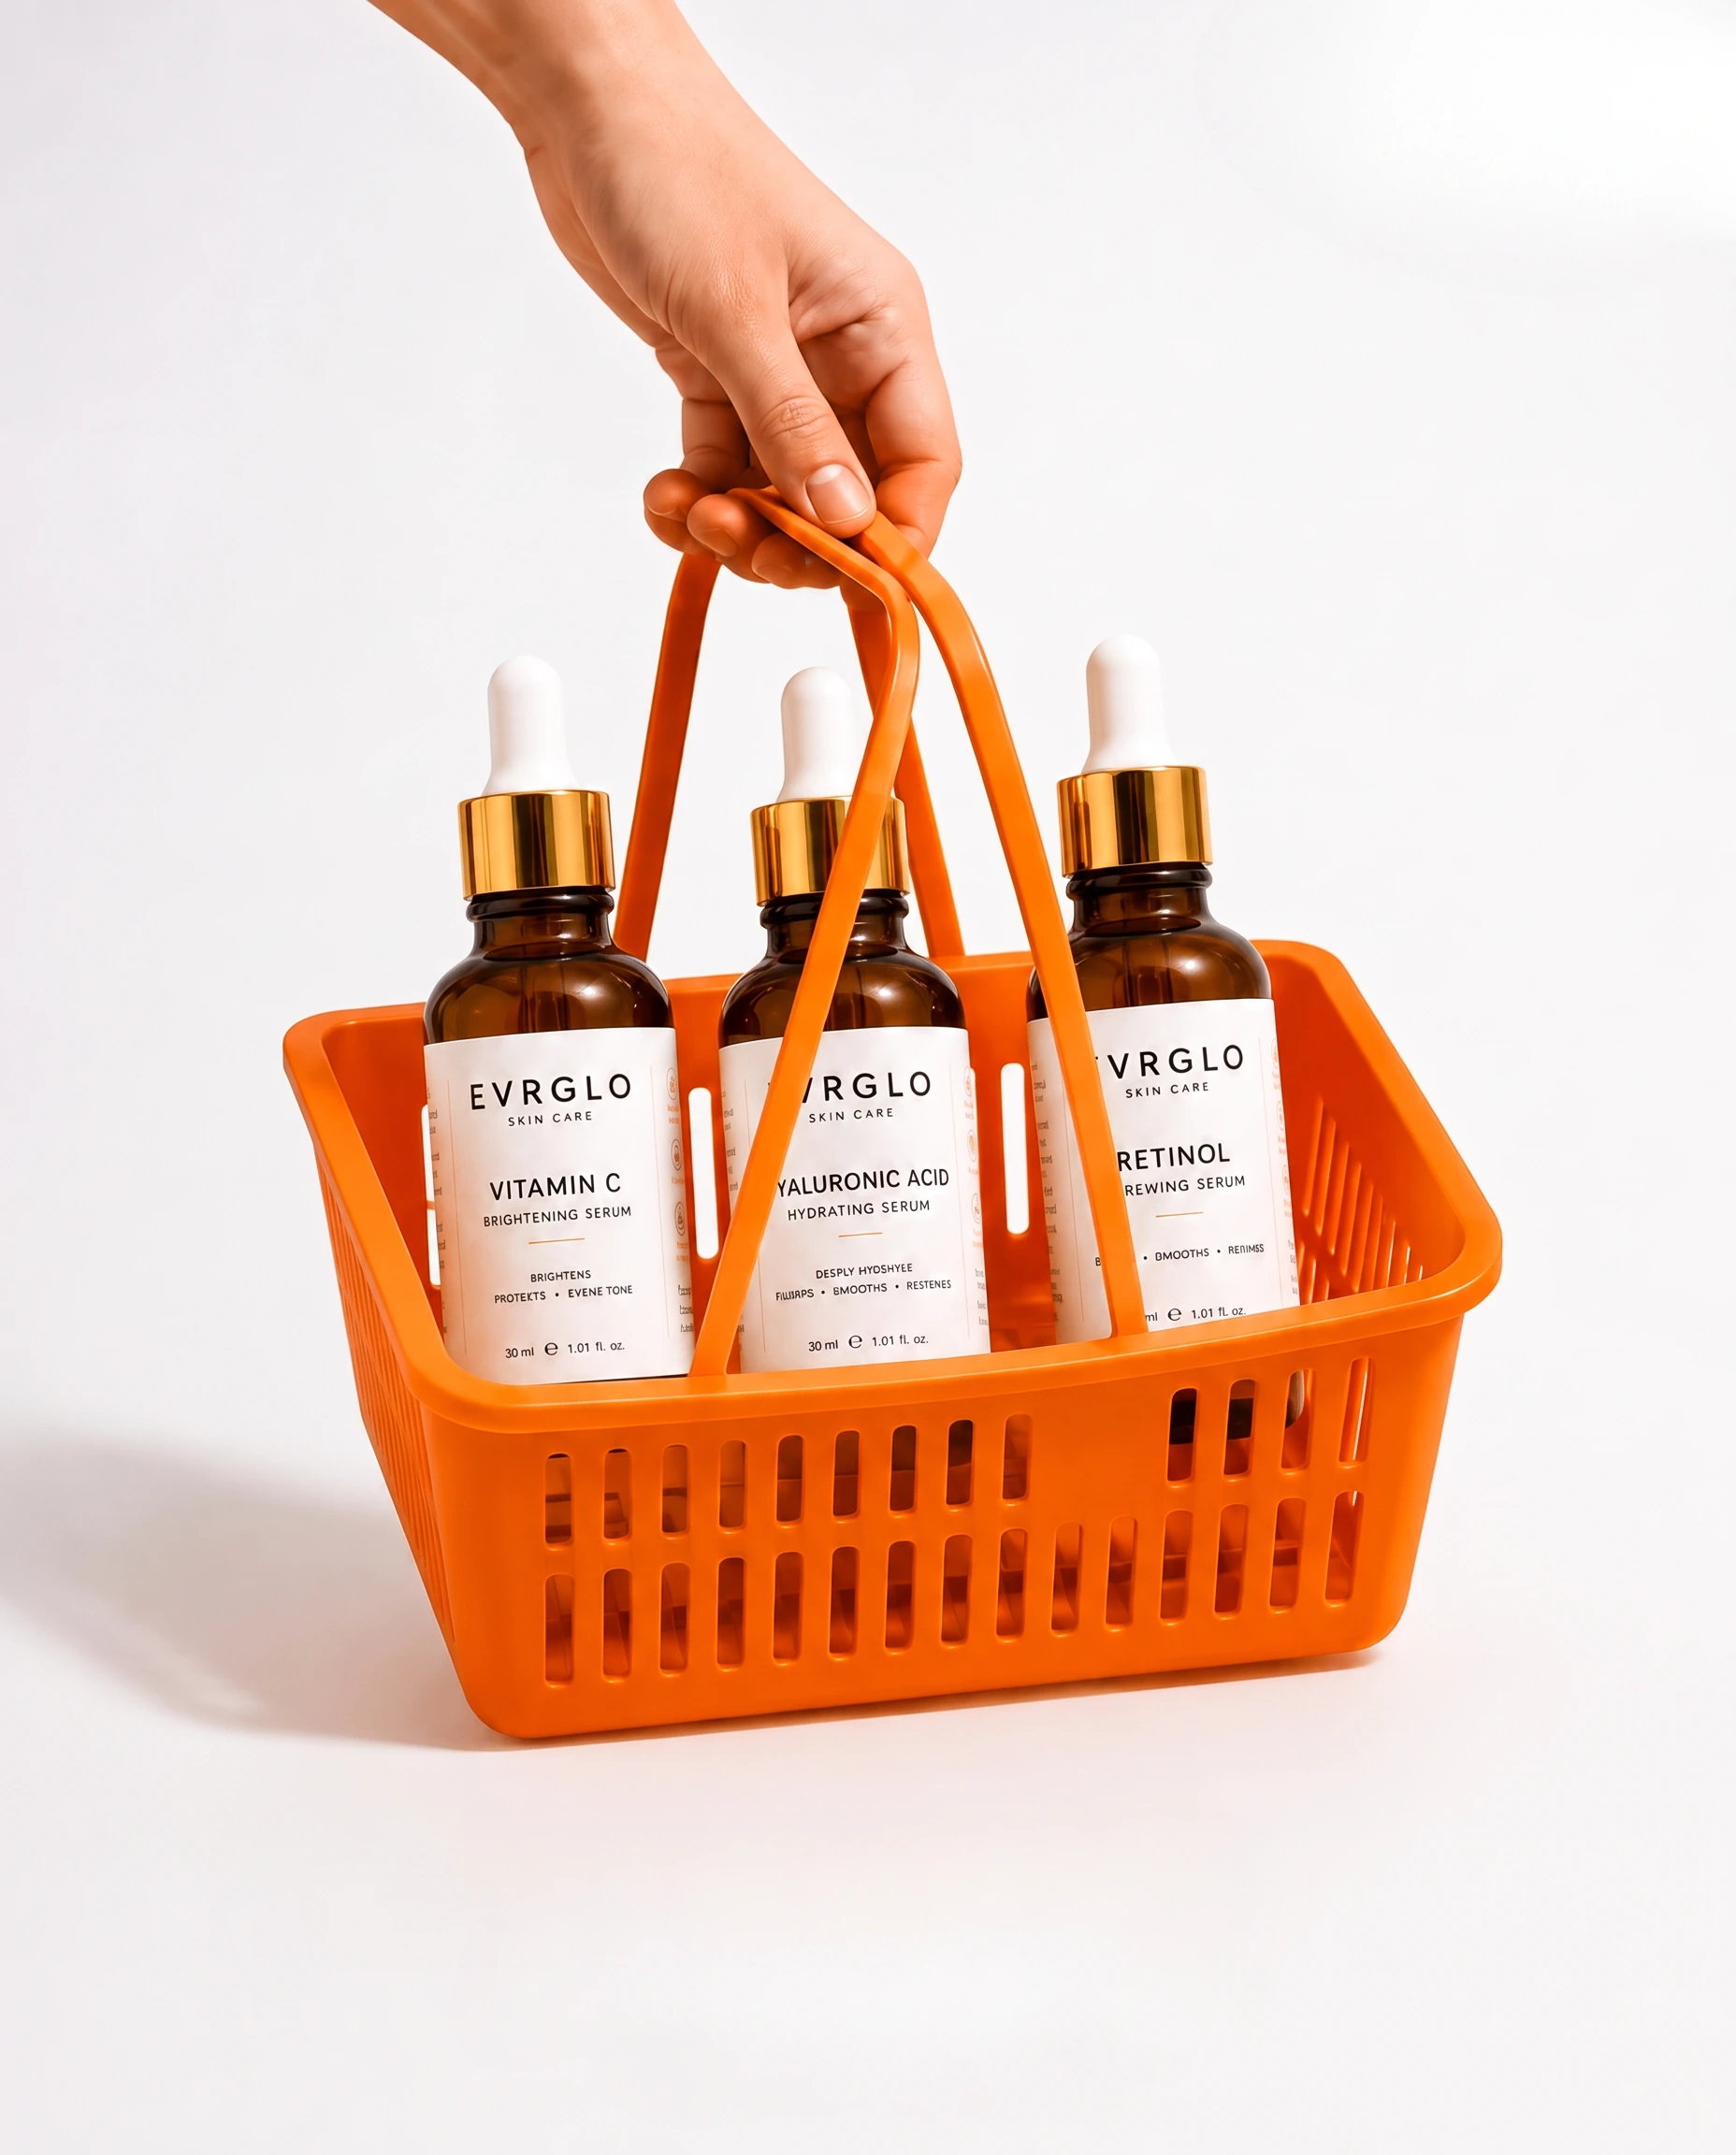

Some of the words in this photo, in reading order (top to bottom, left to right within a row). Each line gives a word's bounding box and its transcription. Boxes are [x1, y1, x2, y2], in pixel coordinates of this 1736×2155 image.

[1094, 1044, 1244, 1080] VRGLO
[470, 1073, 631, 1110] EVRGLO
[1125, 1086, 1161, 1099] SKIN
[1169, 1081, 1209, 1094] CARE
[507, 1114, 543, 1127] SKIN
[552, 1110, 592, 1123] CARE
[808, 1110, 845, 1123] SKIN
[853, 1107, 893, 1120] CARE
[1116, 1142, 1231, 1172] RETINOL
[489, 1174, 595, 1201] VITAMIN
[605, 1172, 621, 1193] C
[777, 1169, 901, 1198] YALURONIC
[906, 1168, 949, 1187] ACID
[1196, 1175, 1246, 1191] SERUM
[483, 1208, 579, 1227] BRIGHTENING
[585, 1206, 631, 1220] SERUM
[788, 1202, 875, 1222] HYDRATING
[881, 1199, 930, 1214] SERUM
[530, 1269, 592, 1283] BRIGHTENS
[816, 1266, 855, 1280] DESPLY
[568, 1287, 603, 1298] EVENE
[605, 1284, 633, 1295] TONE
[906, 1279, 952, 1291] RESTENES
[1191, 1308, 1213, 1320] 1.01
[1218, 1306, 1230, 1317] fl.
[1231, 1307, 1247, 1316] oz.
[505, 1347, 519, 1359] 30
[520, 1346, 535, 1357] ml
[567, 1342, 589, 1354] 1.01
[595, 1341, 606, 1352] fl.
[610, 1342, 626, 1352] oz.
[808, 1340, 822, 1352] 30
[824, 1338, 839, 1351] ml
[872, 1335, 894, 1347] 1.01
[899, 1334, 910, 1345] fl.
[913, 1336, 929, 1344] oz.
